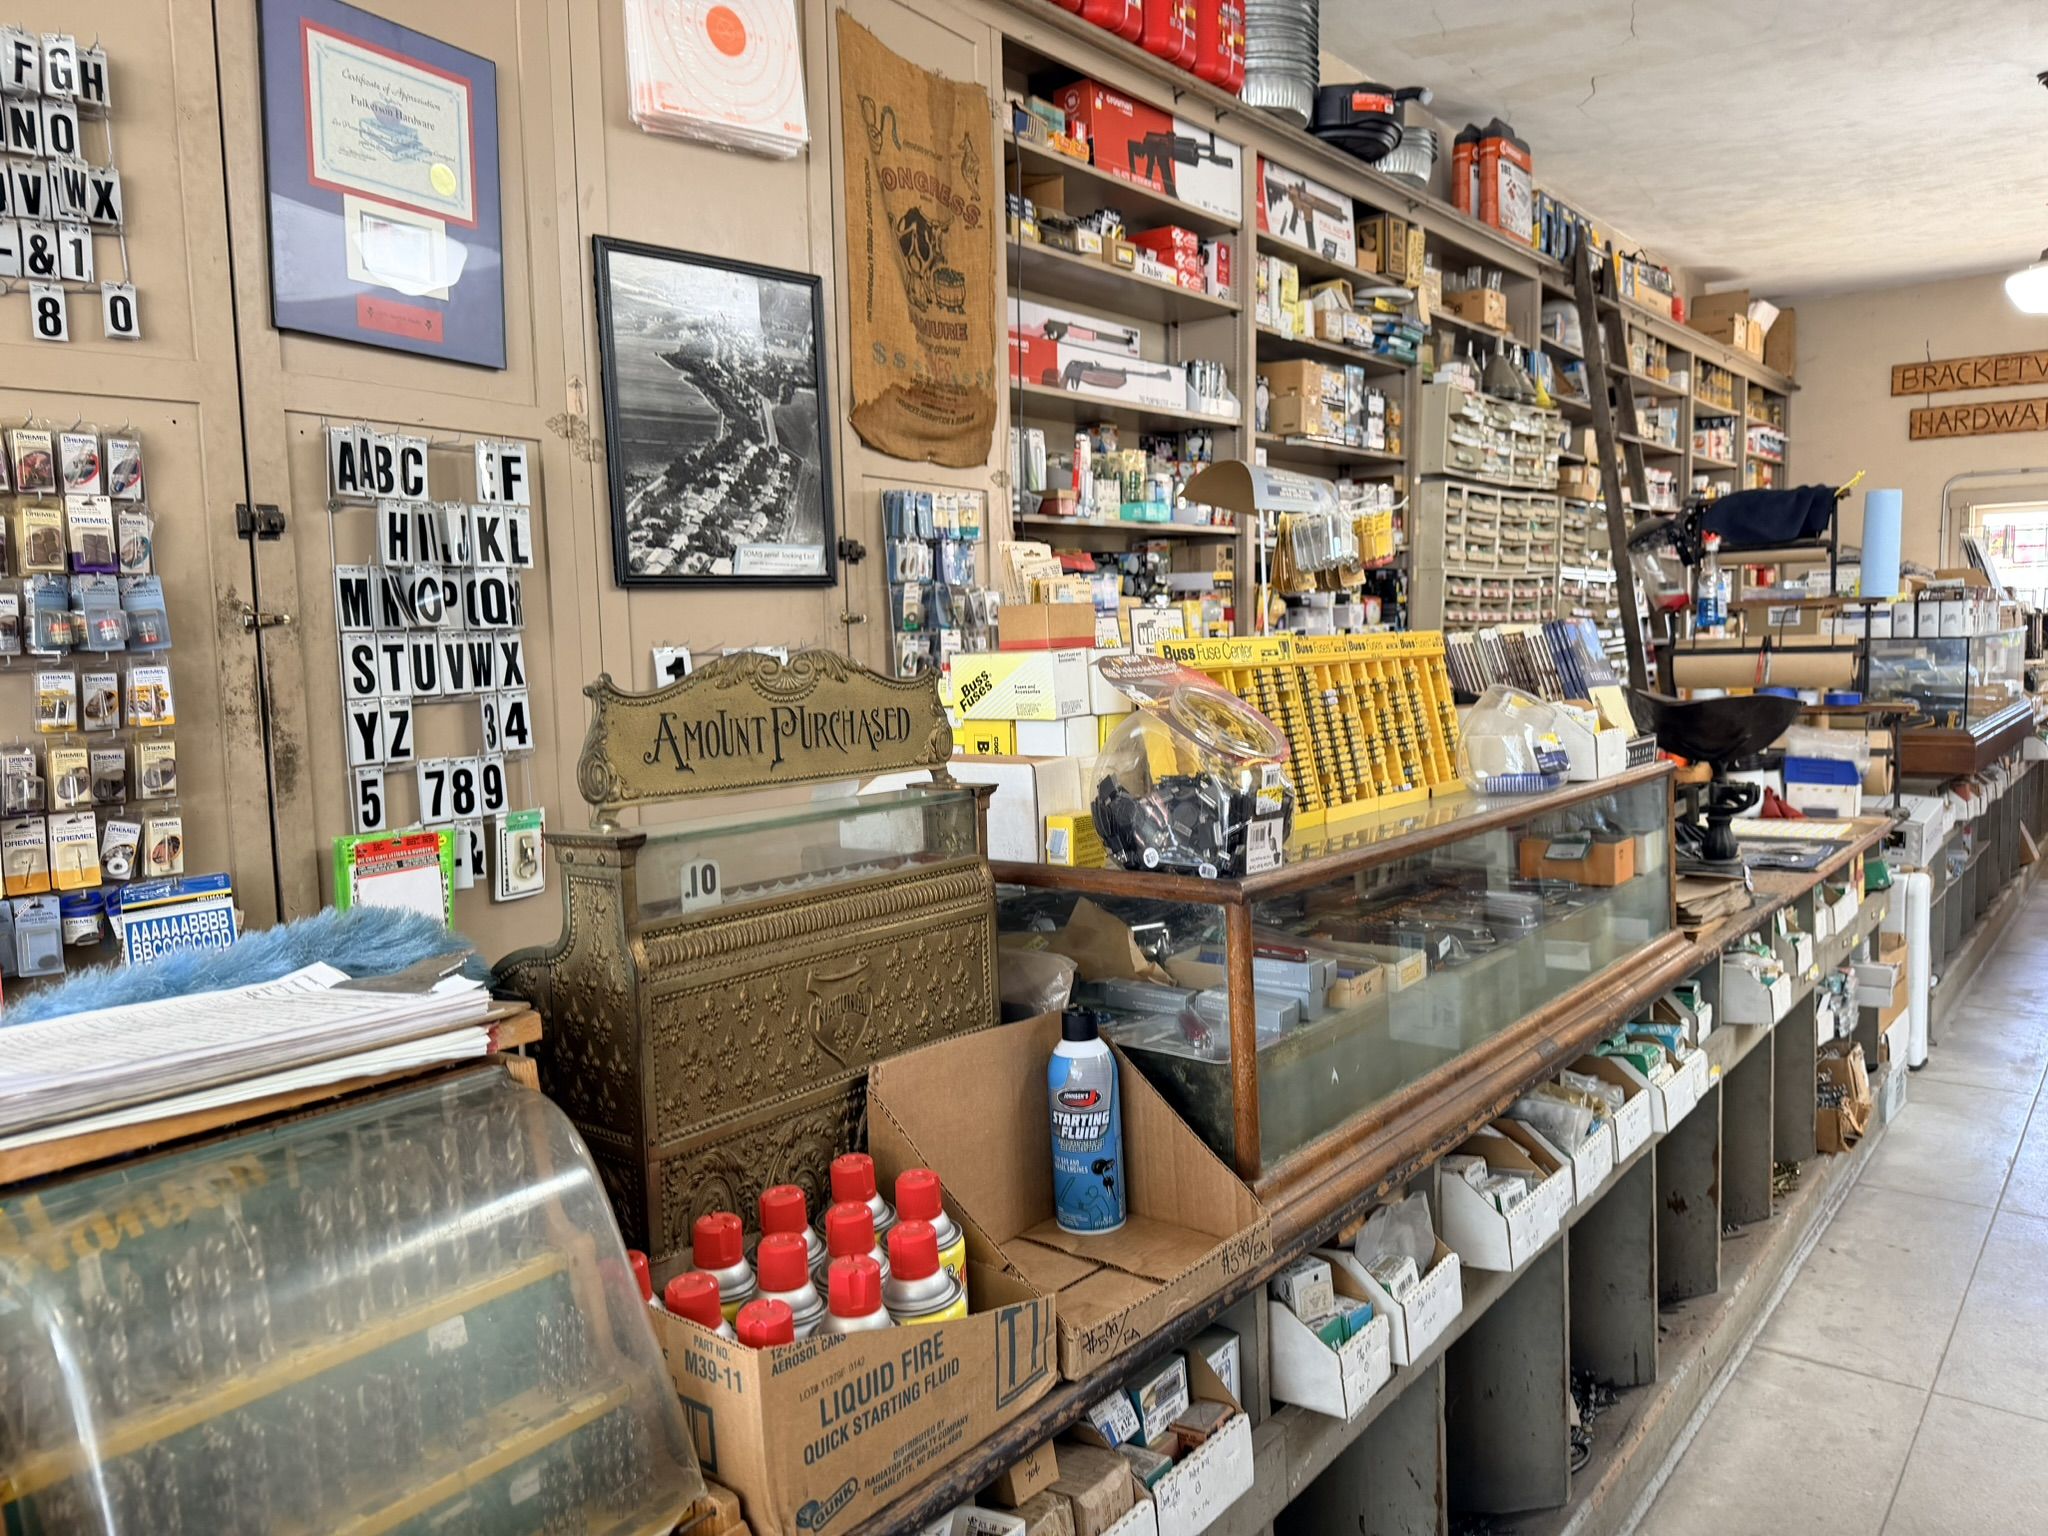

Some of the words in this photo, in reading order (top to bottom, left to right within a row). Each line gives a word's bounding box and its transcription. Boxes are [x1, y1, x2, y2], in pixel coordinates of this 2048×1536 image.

[341, 67, 381, 91] Certificate
[382, 82, 391, 96] of
[391, 87, 441, 112] Appreciation
[350, 94, 394, 118] Fulkerson
[395, 109, 436, 131] Hardware
[879, 166, 982, 226] ONGRESS
[1918, 402, 2048, 435] HARDWA
[16, 432, 49, 442] DREMEL
[25, 510, 58, 519] DREMEL
[70, 516, 110, 526] DREMEL
[119, 517, 146, 526] DREMEL
[1295, 643, 1313, 654] Buss
[1350, 641, 1366, 651] Buss
[1401, 638, 1415, 649] Buss
[1163, 645, 1195, 662] Buss
[1196, 643, 1221, 661] Fuse
[1222, 641, 1254, 660] Center
[42, 674, 73, 682] DREMEL
[84, 675, 115, 683] DREMEL
[135, 668, 166, 676] DREMEL
[961, 670, 989, 699] Buss
[960, 680, 993, 713] Fuses
[643, 709, 767, 774] AMOUNT
[769, 704, 911, 773] PURCHASED
[143, 744, 172, 752] DREMEL
[8, 756, 35, 764] DREMEL
[55, 752, 85, 760] DREMEL
[93, 753, 124, 761] DREMEL
[360, 779, 381, 828] 5
[107, 824, 138, 836] DREMEL
[152, 820, 180, 829] DREMEL
[4, 838, 45, 848] DREMEL
[56, 831, 95, 843] DREMEL
[1053, 1110, 1110, 1126] STARTING
[1061, 1125, 1099, 1140] FLUID
[693, 1335, 713, 1354] PART
[716, 1345, 731, 1362] NO.
[771, 1345, 819, 1377] AEROSOL
[822, 1334, 847, 1352] CANS
[685, 1349, 743, 1394] M39-11
[819, 1361, 895, 1429] LIQUID
[902, 1330, 945, 1382] FIRE
[804, 1422, 850, 1466] QUICK
[853, 1381, 921, 1437] STARTING
[924, 1357, 960, 1394] FLUID
[893, 1424, 935, 1460] DISTRIBUTED
[937, 1419, 945, 1430] BY
[864, 1458, 902, 1489] RADIATOR
[903, 1434, 937, 1466] SPECIALTY
[938, 1414, 969, 1441] COMPANY
[873, 1463, 915, 1496] CHARLOTTE,
[916, 1454, 926, 1467] NC
[814, 1484, 853, 1527] GUNK
